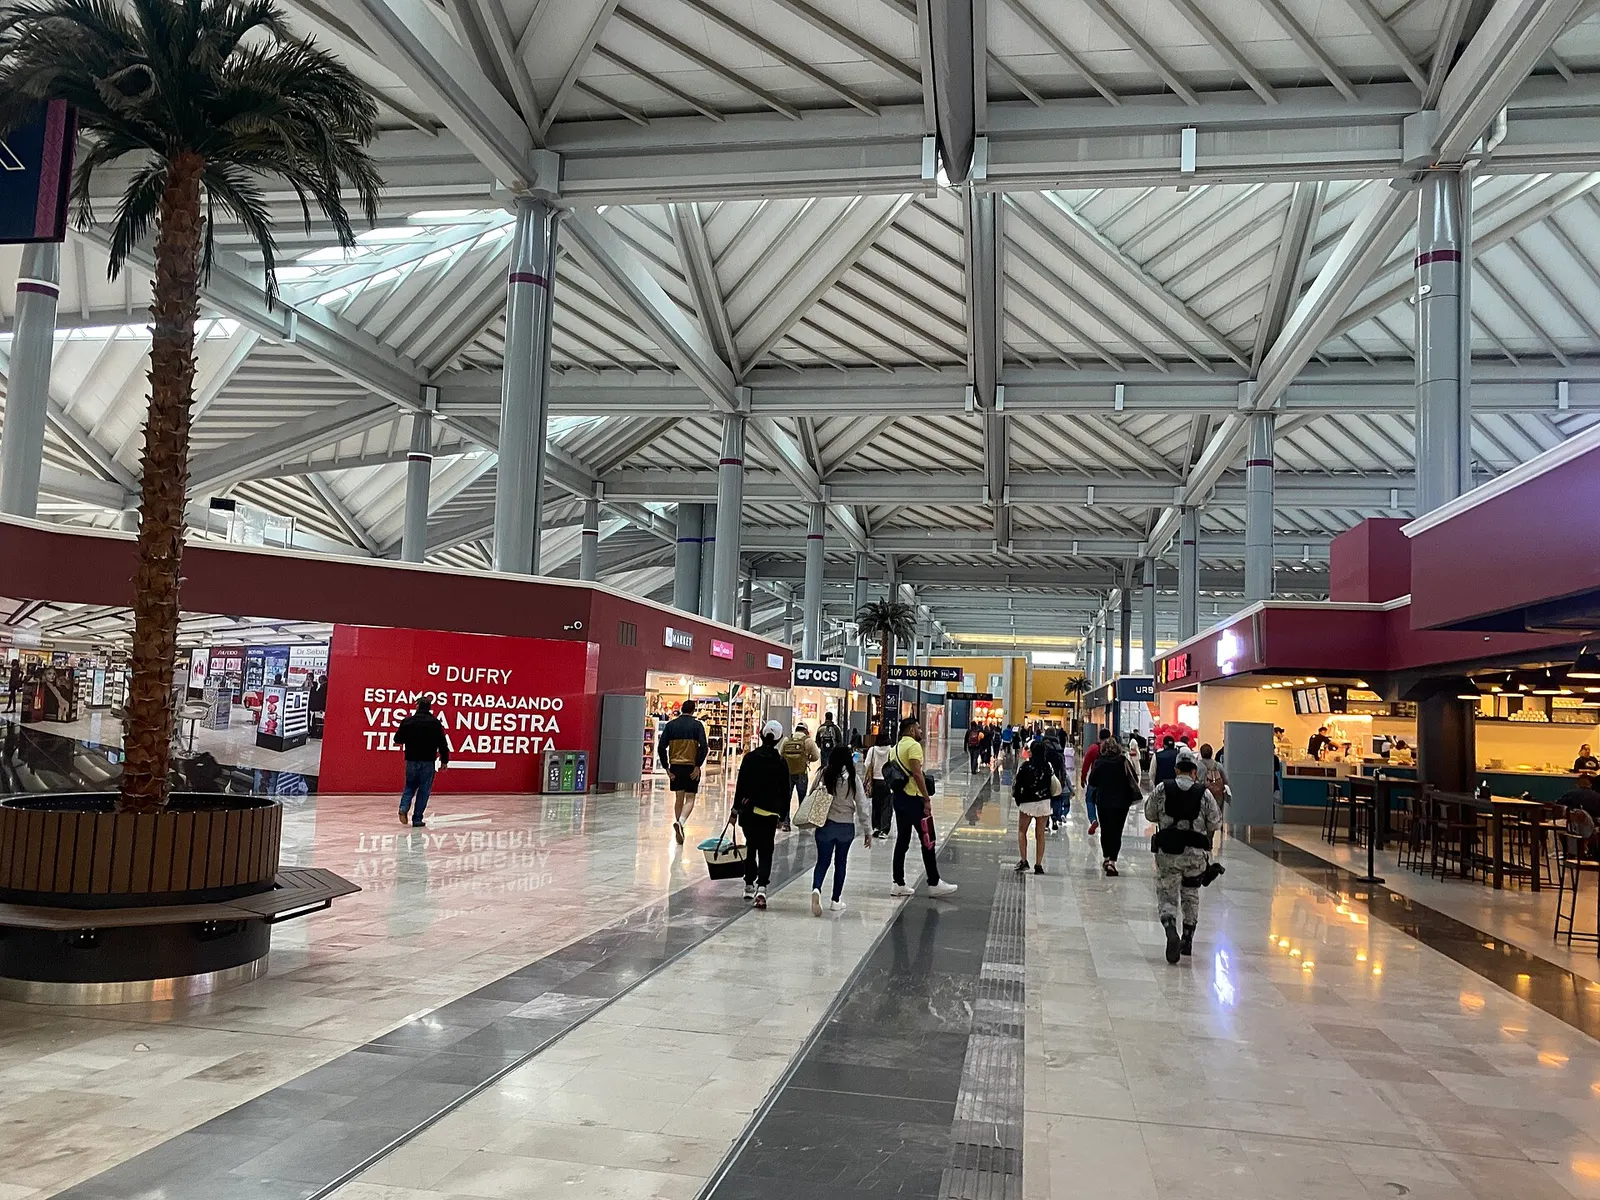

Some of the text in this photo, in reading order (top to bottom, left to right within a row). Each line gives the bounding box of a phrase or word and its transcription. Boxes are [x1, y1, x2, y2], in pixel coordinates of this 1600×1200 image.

[672, 633, 692, 647] MARKET
[446, 666, 513, 685] DUFRY
[796, 667, 838, 682] crocs
[890, 668, 902, 677] 109
[364, 687, 563, 712] ESTAMOS TRABAJANDO
[364, 707, 560, 733] VISA NUESTRA
[363, 731, 556, 754] TIEA ABIERTA
